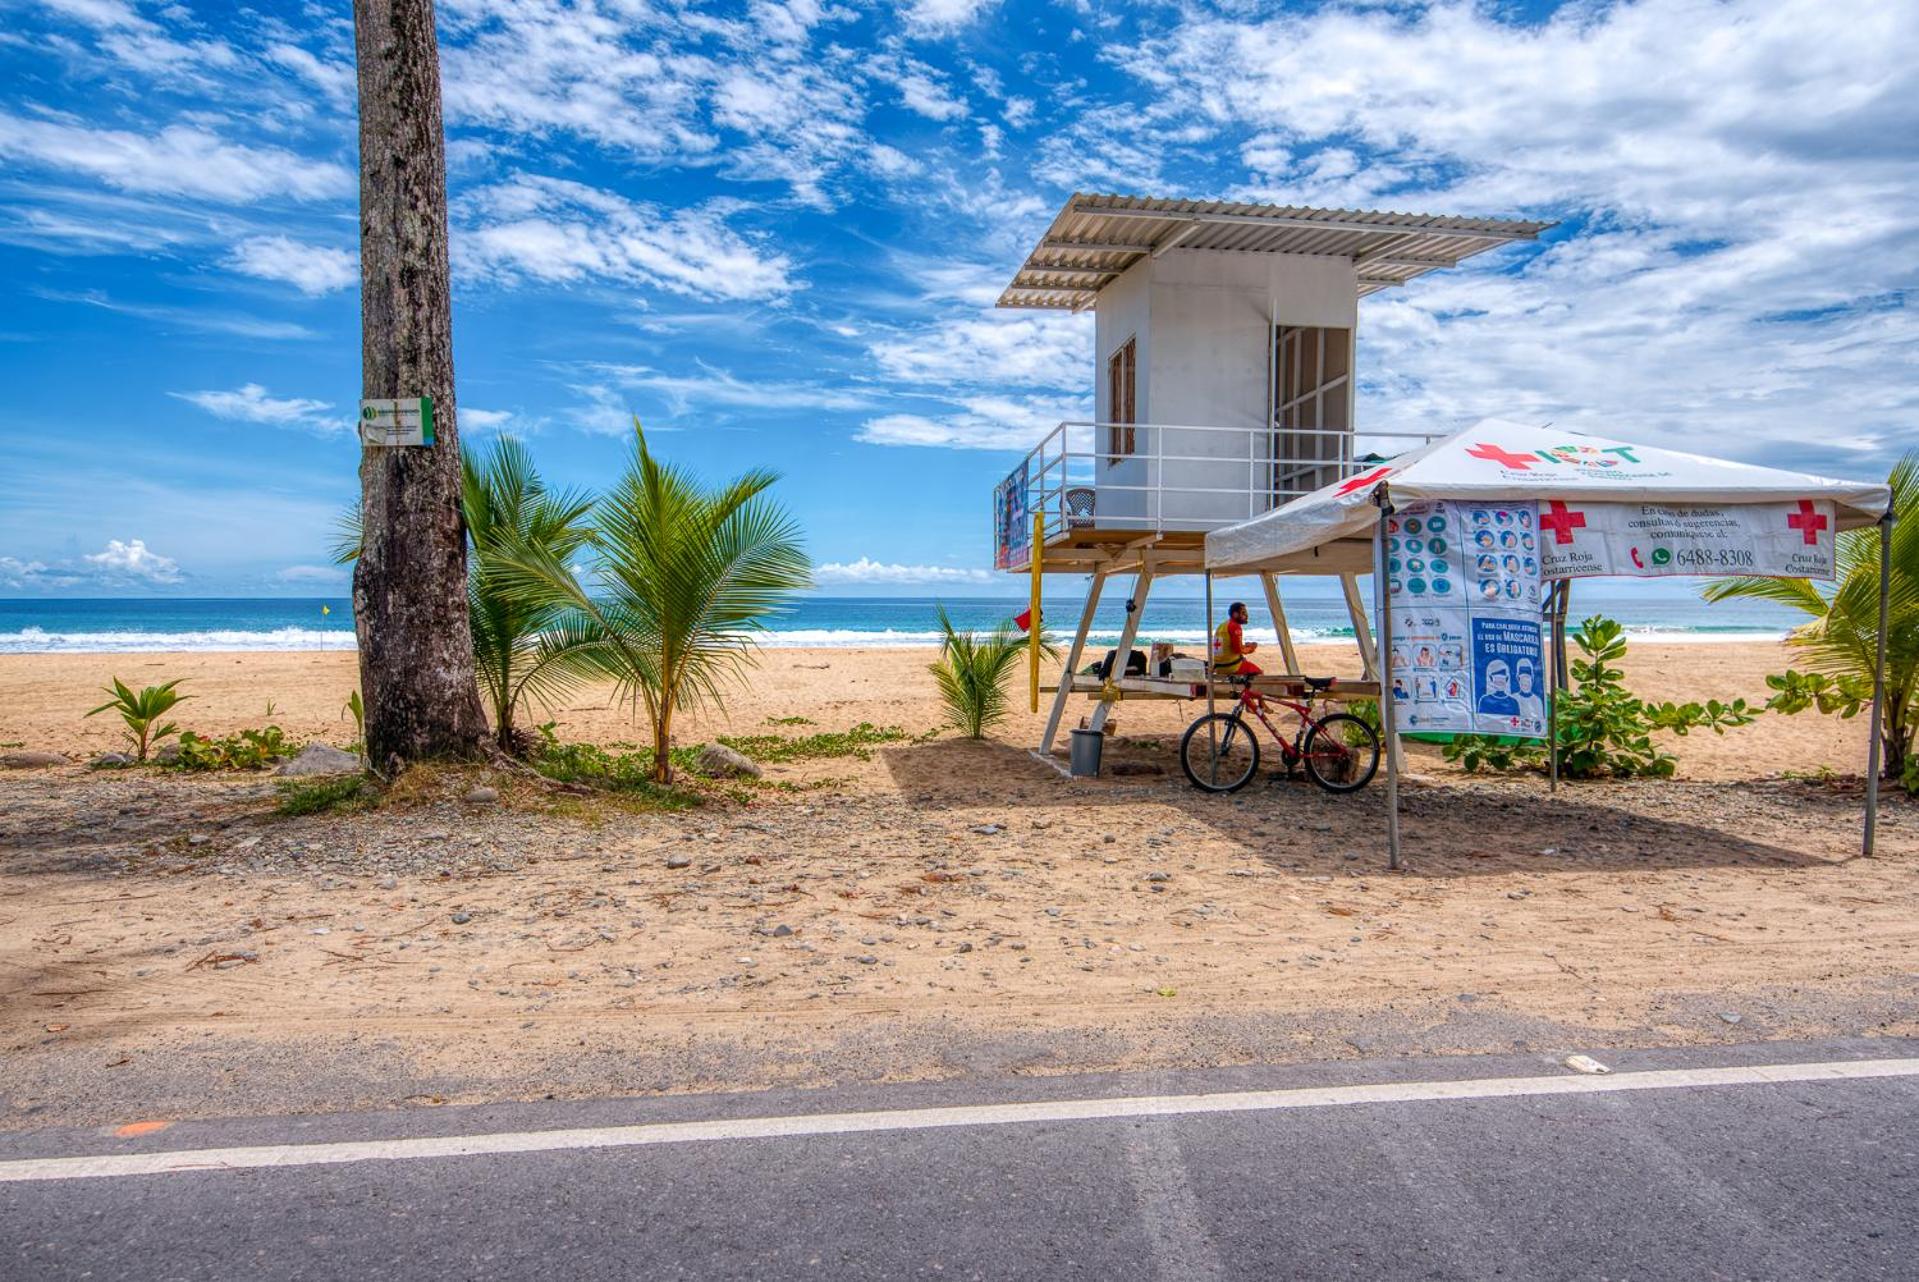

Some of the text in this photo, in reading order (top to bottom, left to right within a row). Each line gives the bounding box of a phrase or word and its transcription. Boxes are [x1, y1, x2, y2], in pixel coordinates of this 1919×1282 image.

[1641, 506, 1656, 516] En
[1677, 509, 1689, 518] de
[1683, 518, 1741, 530] sugerencias,
[1542, 551, 1593, 565] Cruz Roja
[1676, 548, 1754, 567] 6488-8308
[1792, 553, 1812, 563] Cruz
[1543, 565, 1603, 576] ostarricense
[1485, 643, 1496, 653] ES
